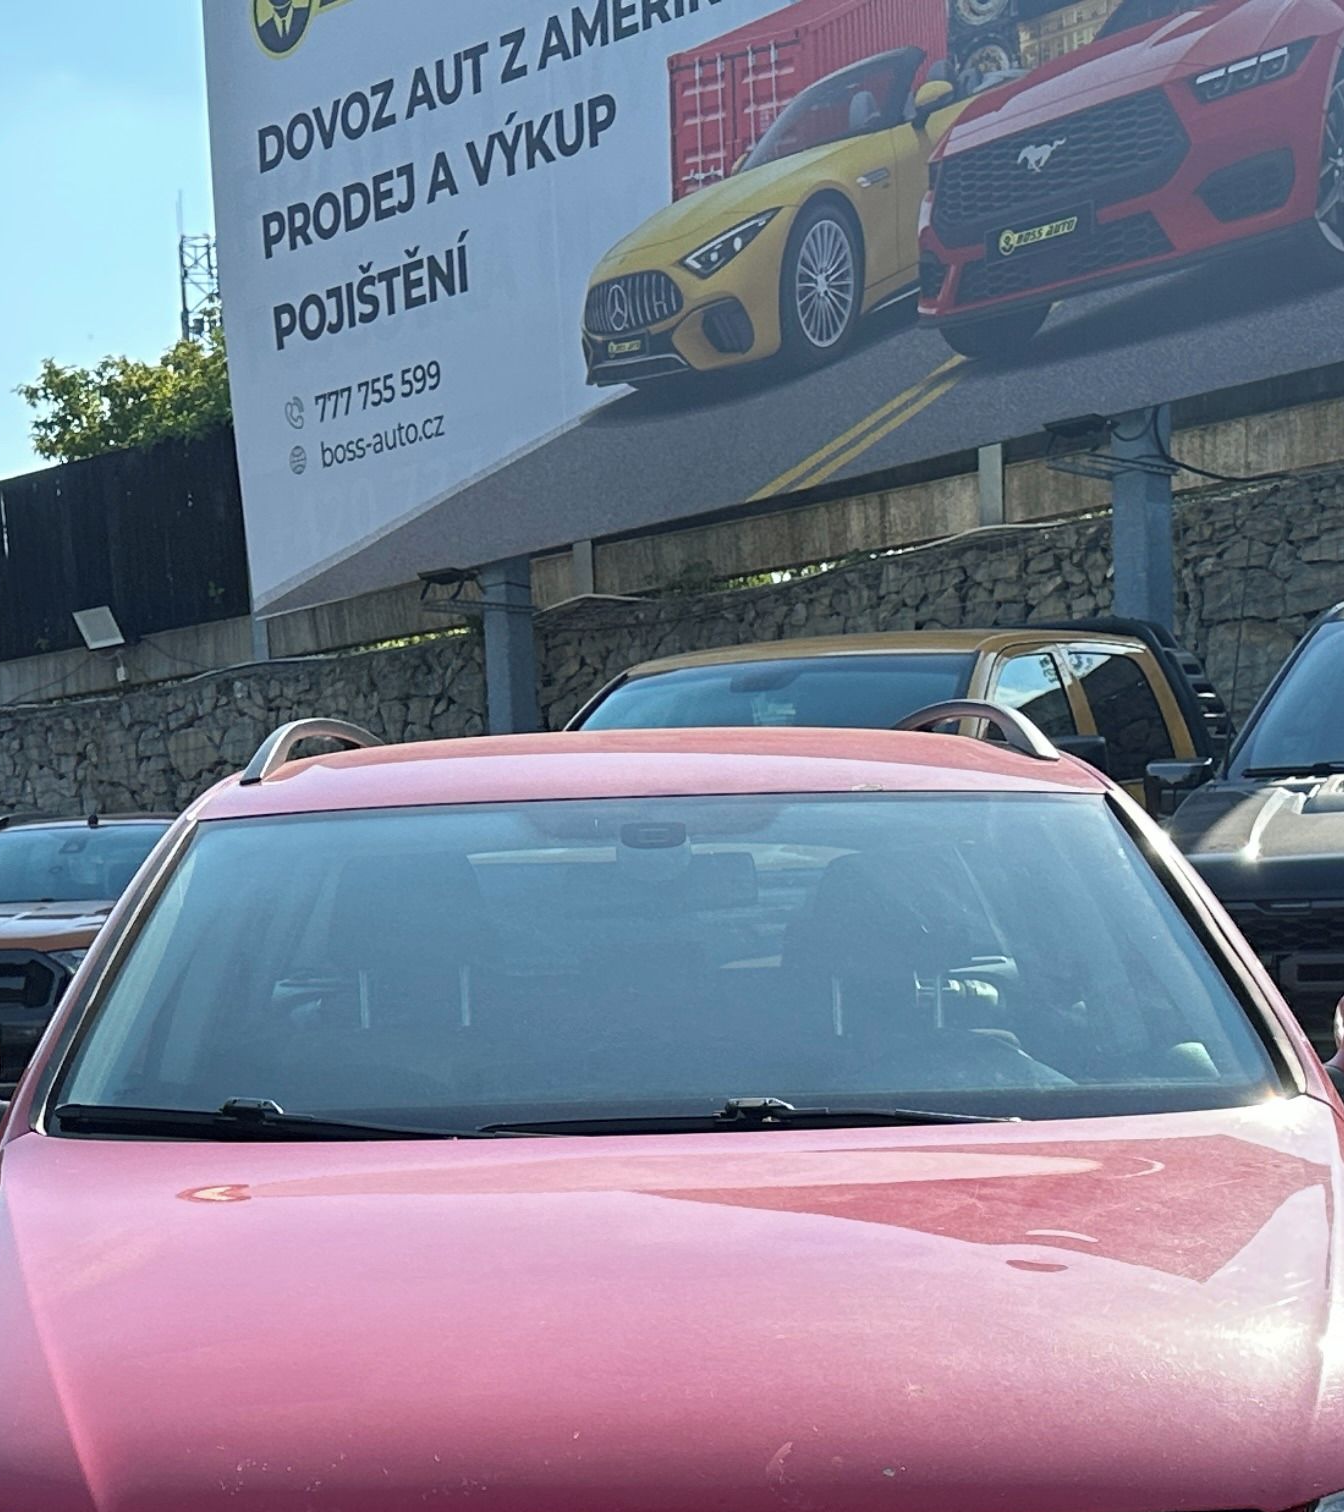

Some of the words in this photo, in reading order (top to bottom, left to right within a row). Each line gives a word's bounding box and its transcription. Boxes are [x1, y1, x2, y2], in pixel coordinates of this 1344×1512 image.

[257, 78, 396, 174] DOVOZ
[405, 41, 489, 120] AUT
[500, 27, 528, 84] Z
[537, 0, 723, 71] AMER
[262, 162, 416, 260] PRODEJ
[426, 151, 459, 205] A
[465, 93, 616, 187] VÝKUP
[273, 229, 470, 351] POJIŠTĚNÍ
[314, 386, 352, 423] 777
[357, 373, 396, 411] 755
[400, 360, 441, 398] 599
[320, 415, 446, 468] boss-auto.cz
